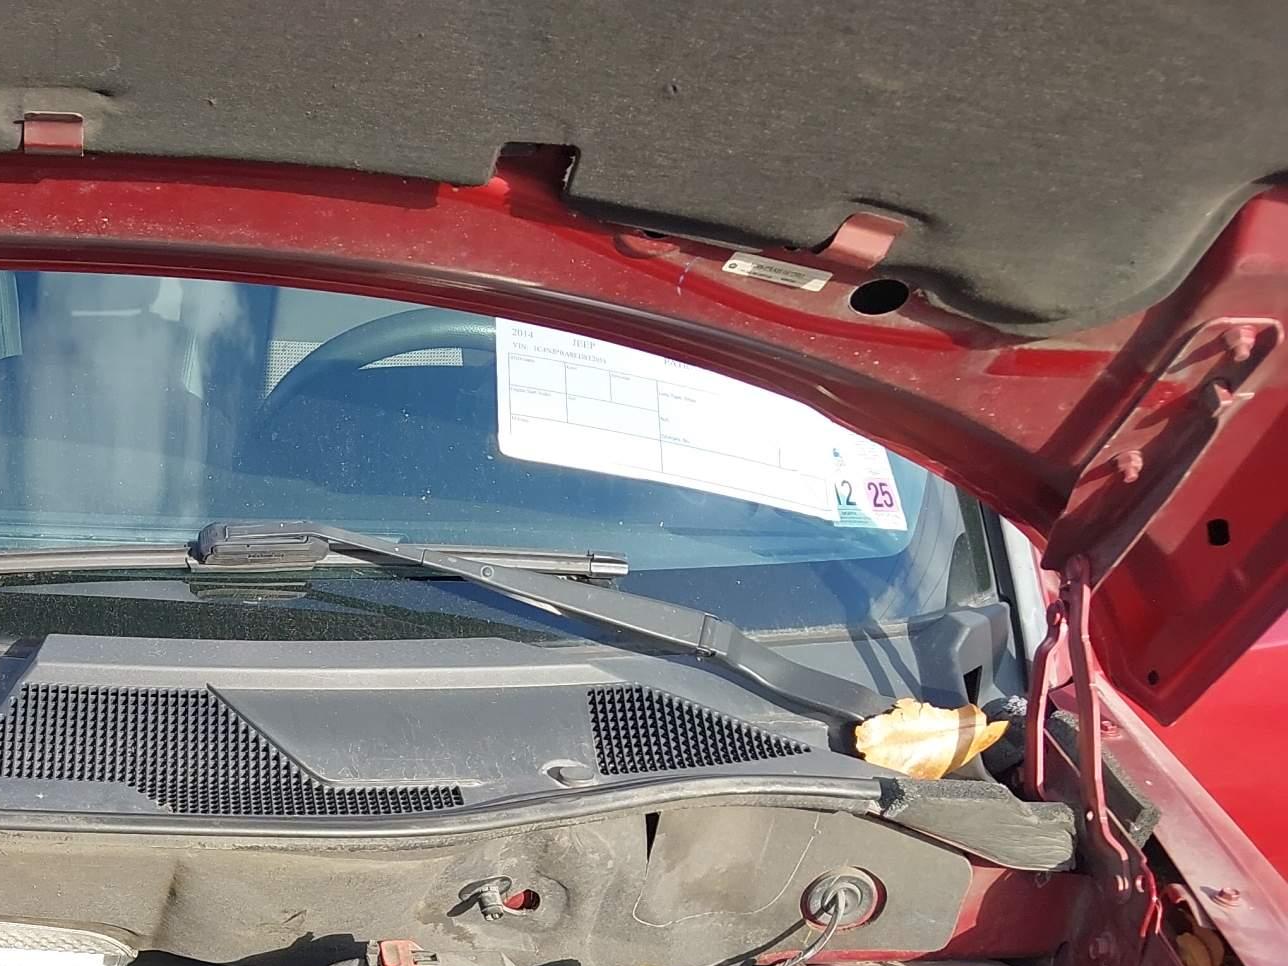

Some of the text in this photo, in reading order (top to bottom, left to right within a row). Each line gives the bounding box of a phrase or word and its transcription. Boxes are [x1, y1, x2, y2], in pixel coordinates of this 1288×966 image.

[512, 328, 534, 339] 2014
[571, 338, 597, 350] JEEP
[834, 480, 894, 508] 12 25
